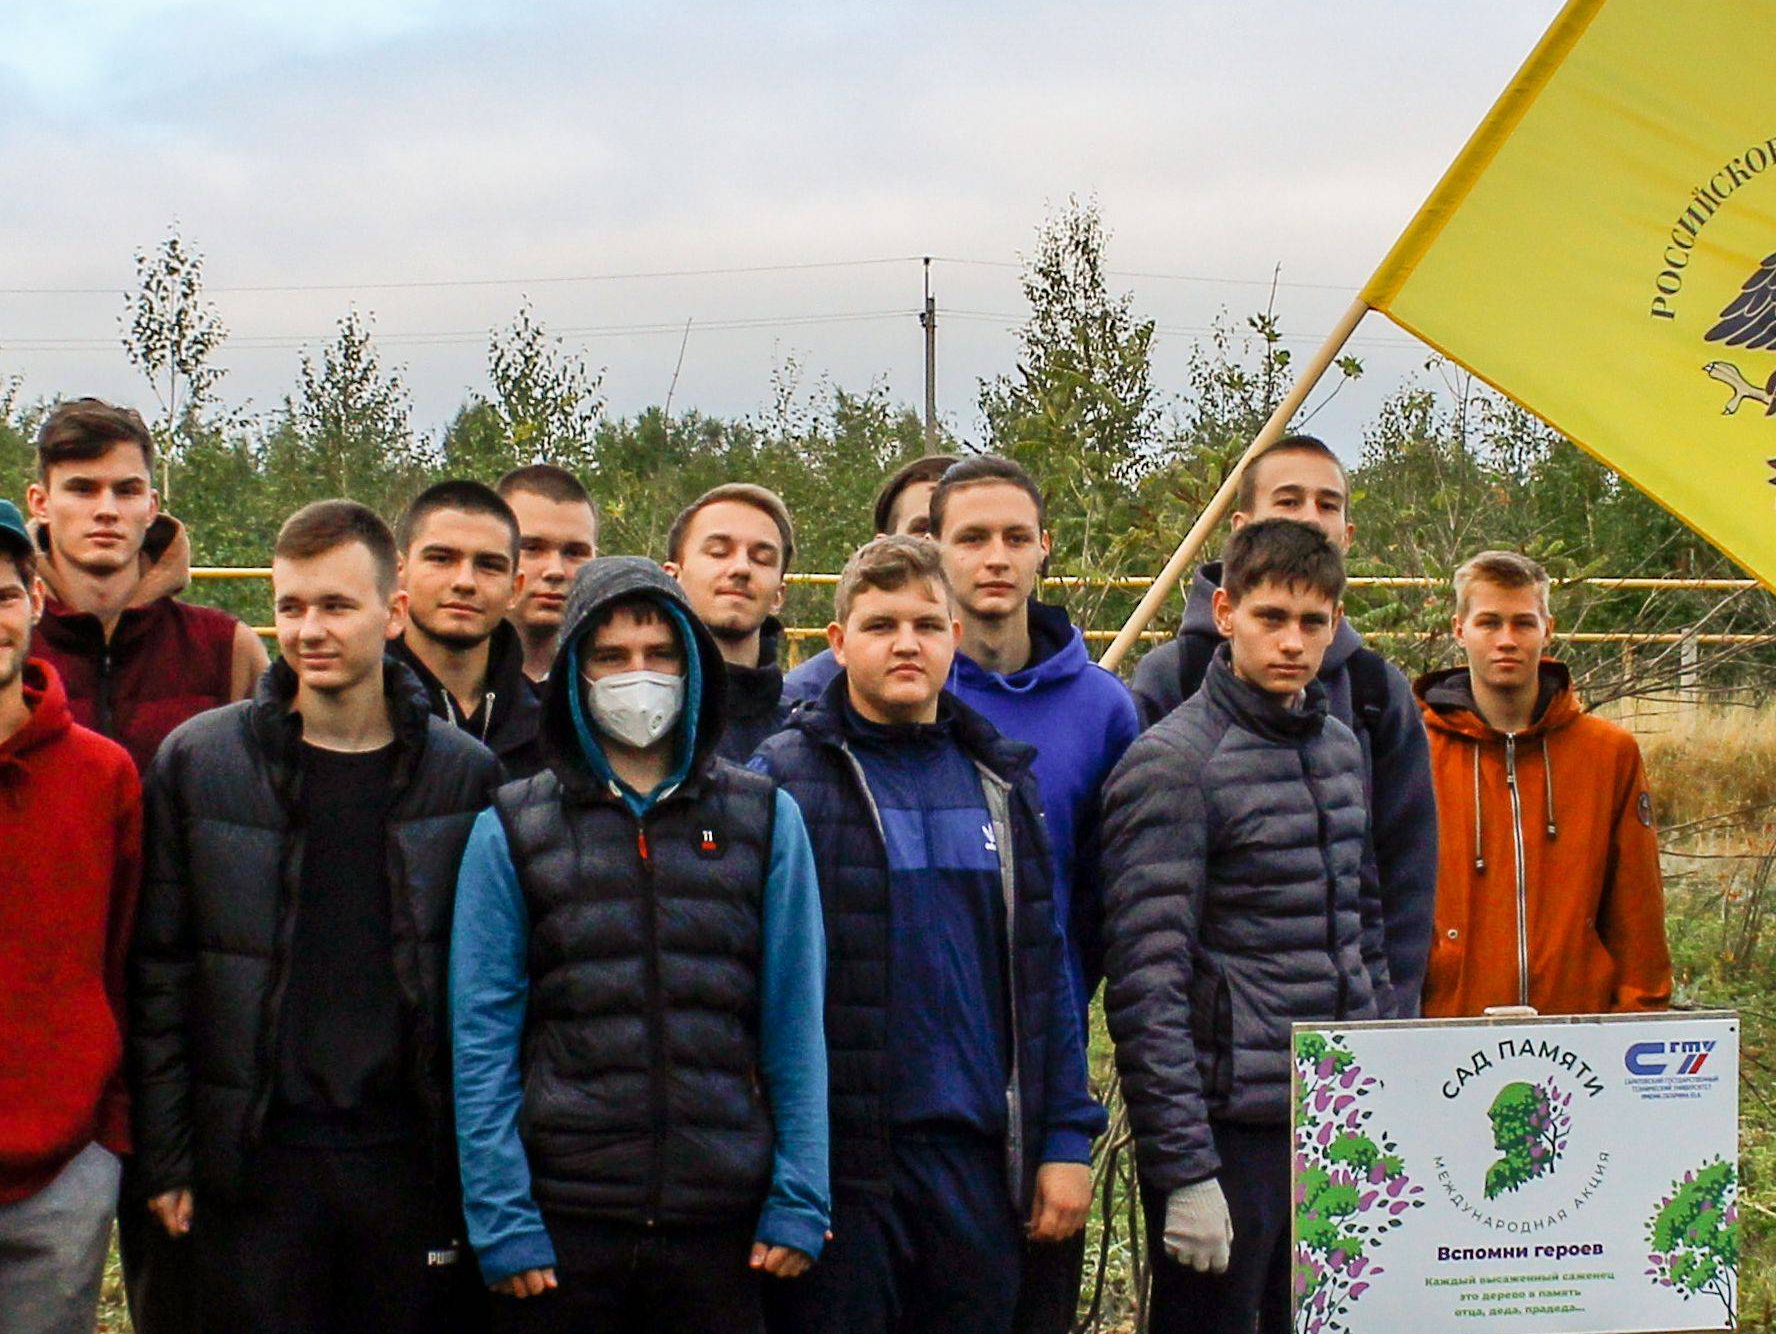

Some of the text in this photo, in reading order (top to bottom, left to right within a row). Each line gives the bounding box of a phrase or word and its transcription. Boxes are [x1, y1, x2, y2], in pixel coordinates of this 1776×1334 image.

[1442, 1039, 1604, 1099] САД ПАМЯТИ
[1433, 1152, 1610, 1234] МЕЖДУНАРОДНАЯ АКЦИЯ
[1437, 1243, 1604, 1262] Вспомни героев
[1425, 1270, 1615, 1287] Каждый высаженный саженец
[1460, 1292, 1478, 1301] это
[1482, 1291, 1526, 1302] дерево
[1539, 1289, 1581, 1298] память
[1454, 1308, 1485, 1317] отца,
[1489, 1306, 1522, 1316] деда,
